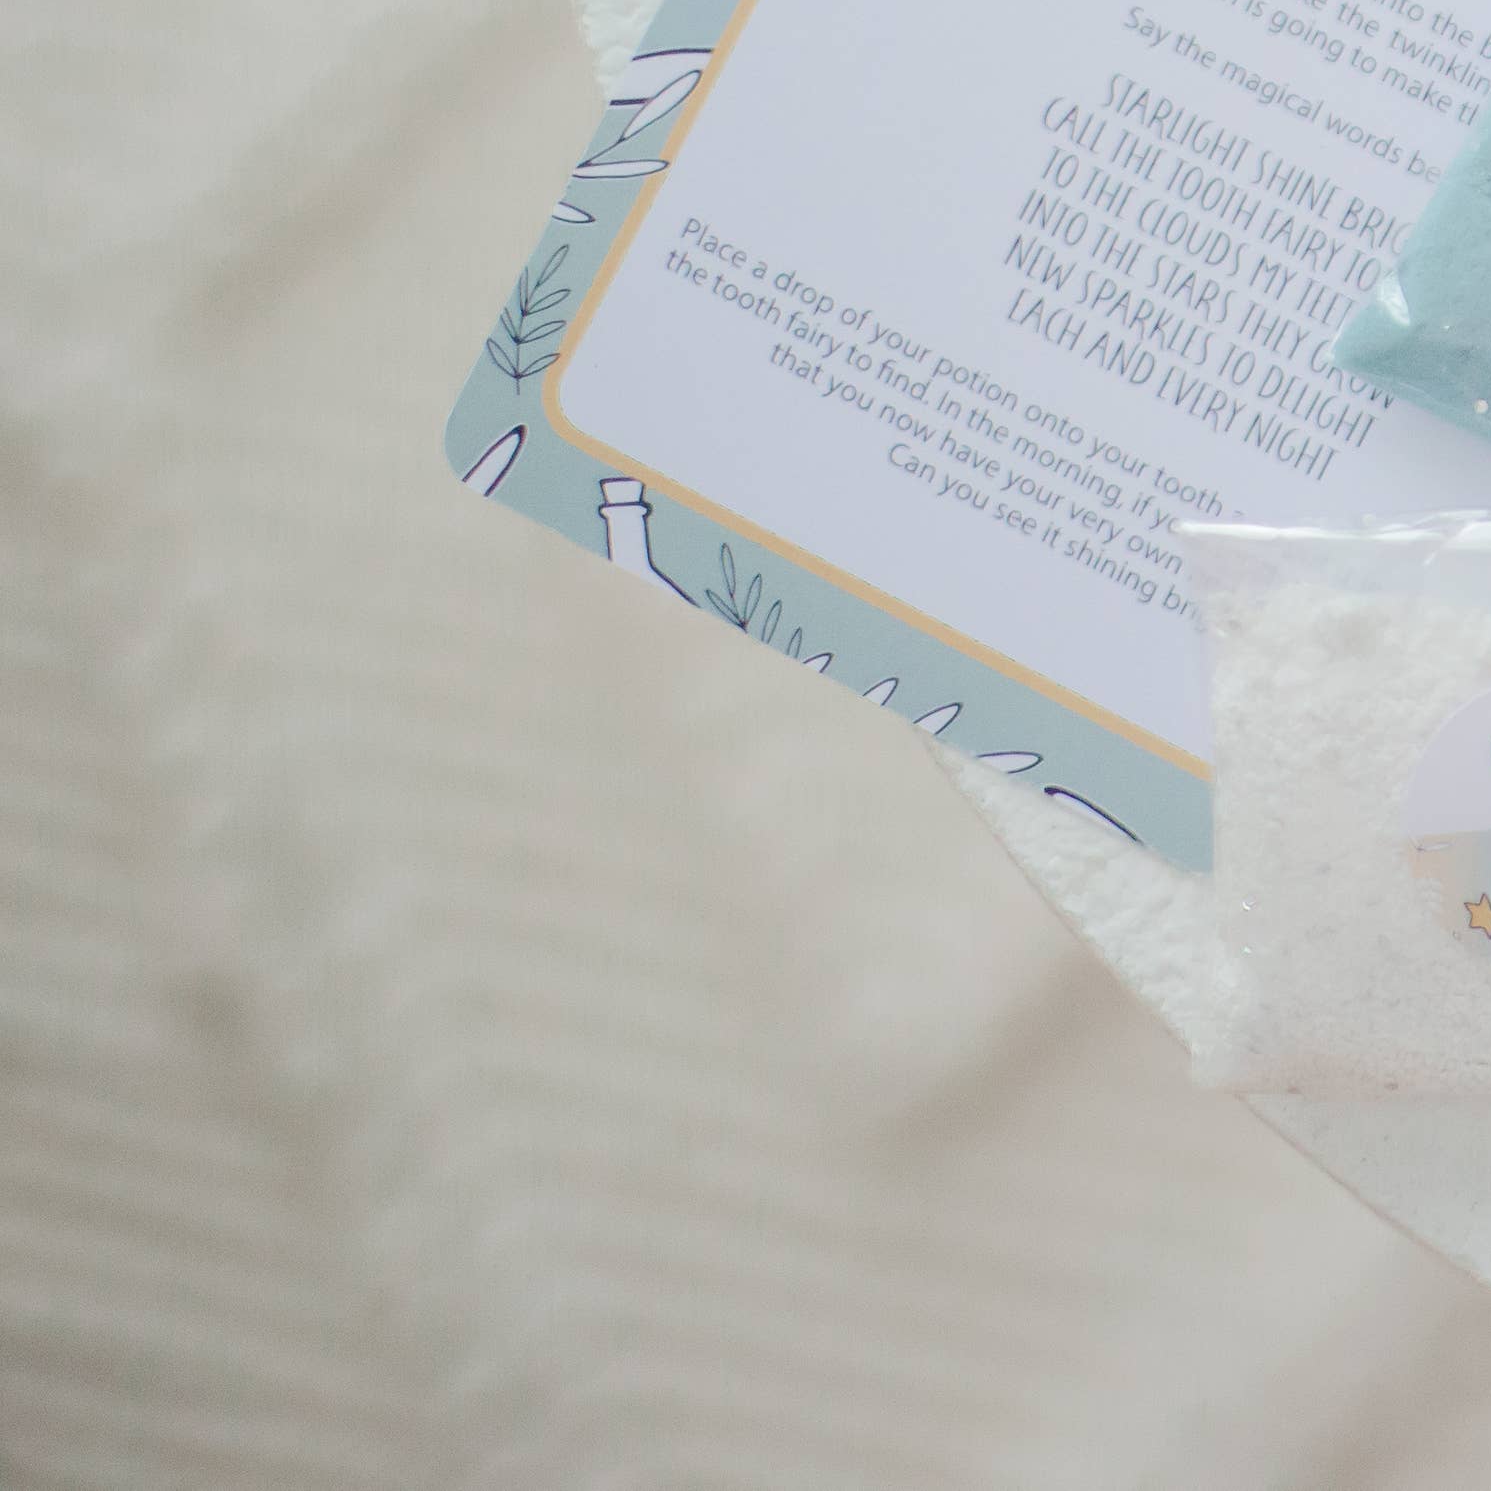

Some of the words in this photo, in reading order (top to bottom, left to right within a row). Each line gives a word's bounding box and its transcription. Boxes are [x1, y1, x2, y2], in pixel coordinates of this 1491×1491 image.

[1123, 6, 1172, 48] Say
[1172, 32, 1216, 70] the
[1219, 60, 1324, 123] magical
[1324, 112, 1403, 165] words
[1430, 11, 1474, 48] the
[1040, 145, 1079, 189] TO
[1081, 166, 1136, 219] THE
[1137, 199, 1247, 277] CLOUDS
[1248, 254, 1298, 301] MY
[1041, 97, 1107, 154] CALL
[1110, 129, 1163, 182] THE
[1165, 158, 1261, 231] TOOTH
[1260, 208, 1345, 272] FAIRY
[1101, 72, 1252, 172] STARLIGHT
[1251, 150, 1342, 220] SHINE
[1003, 233, 1077, 292] NEW
[1075, 270, 1215, 366] SPARKLES
[1217, 342, 1256, 386] TO
[1256, 364, 1376, 448] DELIGHT
[1017, 188, 1089, 247] INTO
[1090, 224, 1145, 277] THE
[1146, 254, 1236, 324] STARS
[1237, 300, 1311, 361] THEY
[679, 217, 748, 269] Place
[751, 260, 768, 280] a
[773, 270, 835, 316] drop
[839, 307, 874, 331] of
[866, 322, 933, 364] your
[930, 356, 1018, 412] potion
[1023, 404, 1085, 446] onto
[1085, 436, 1150, 478] your
[1153, 466, 1223, 518] tooth
[1006, 287, 1087, 352] EACH
[1083, 331, 1156, 386] AND
[1155, 366, 1247, 433] EVERY
[1243, 411, 1339, 481] NIGHT
